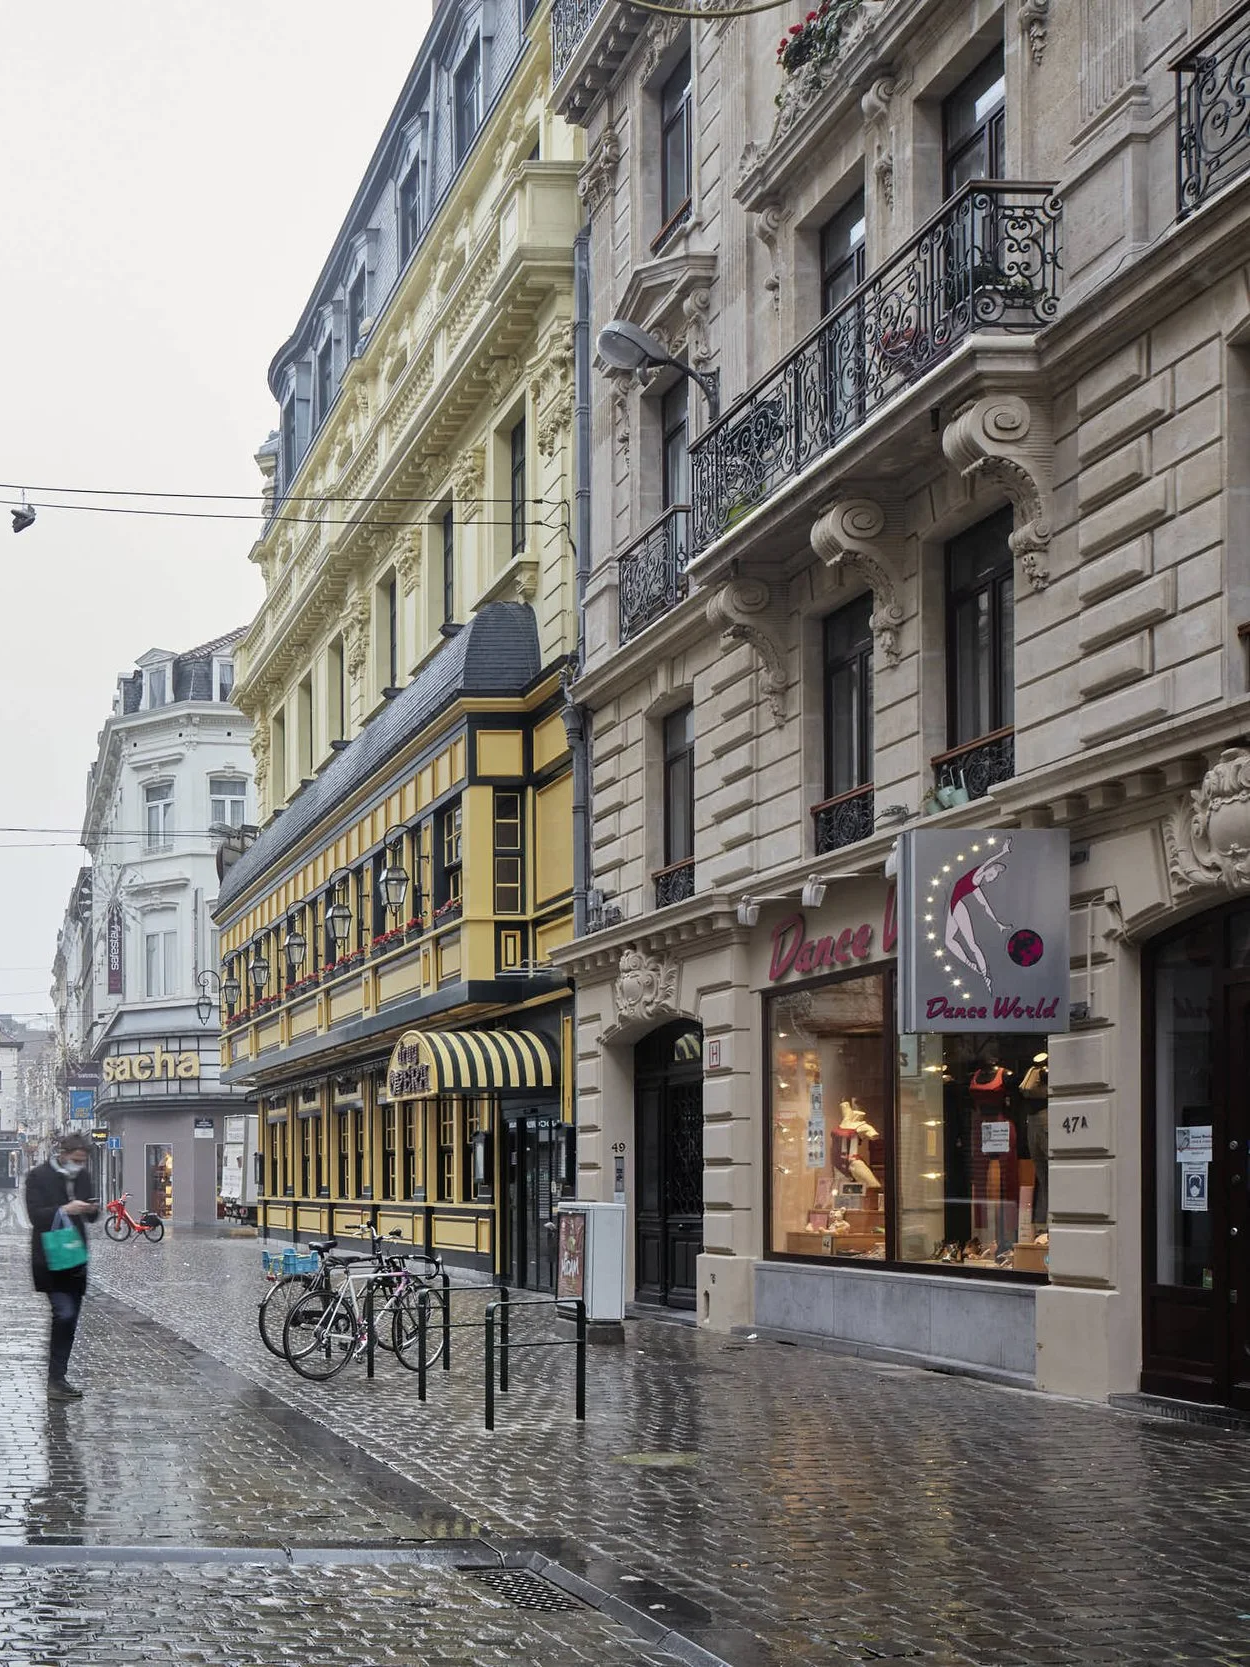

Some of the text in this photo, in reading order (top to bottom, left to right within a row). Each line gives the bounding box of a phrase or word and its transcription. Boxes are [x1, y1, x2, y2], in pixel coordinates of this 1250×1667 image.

[110, 925, 121, 970] safestay
[769, 913, 871, 981] Dance
[926, 996, 1060, 1020] Dance World
[103, 1045, 200, 1081] sacha
[1062, 1115, 1088, 1134] 47A
[611, 1142, 626, 1153] 49
